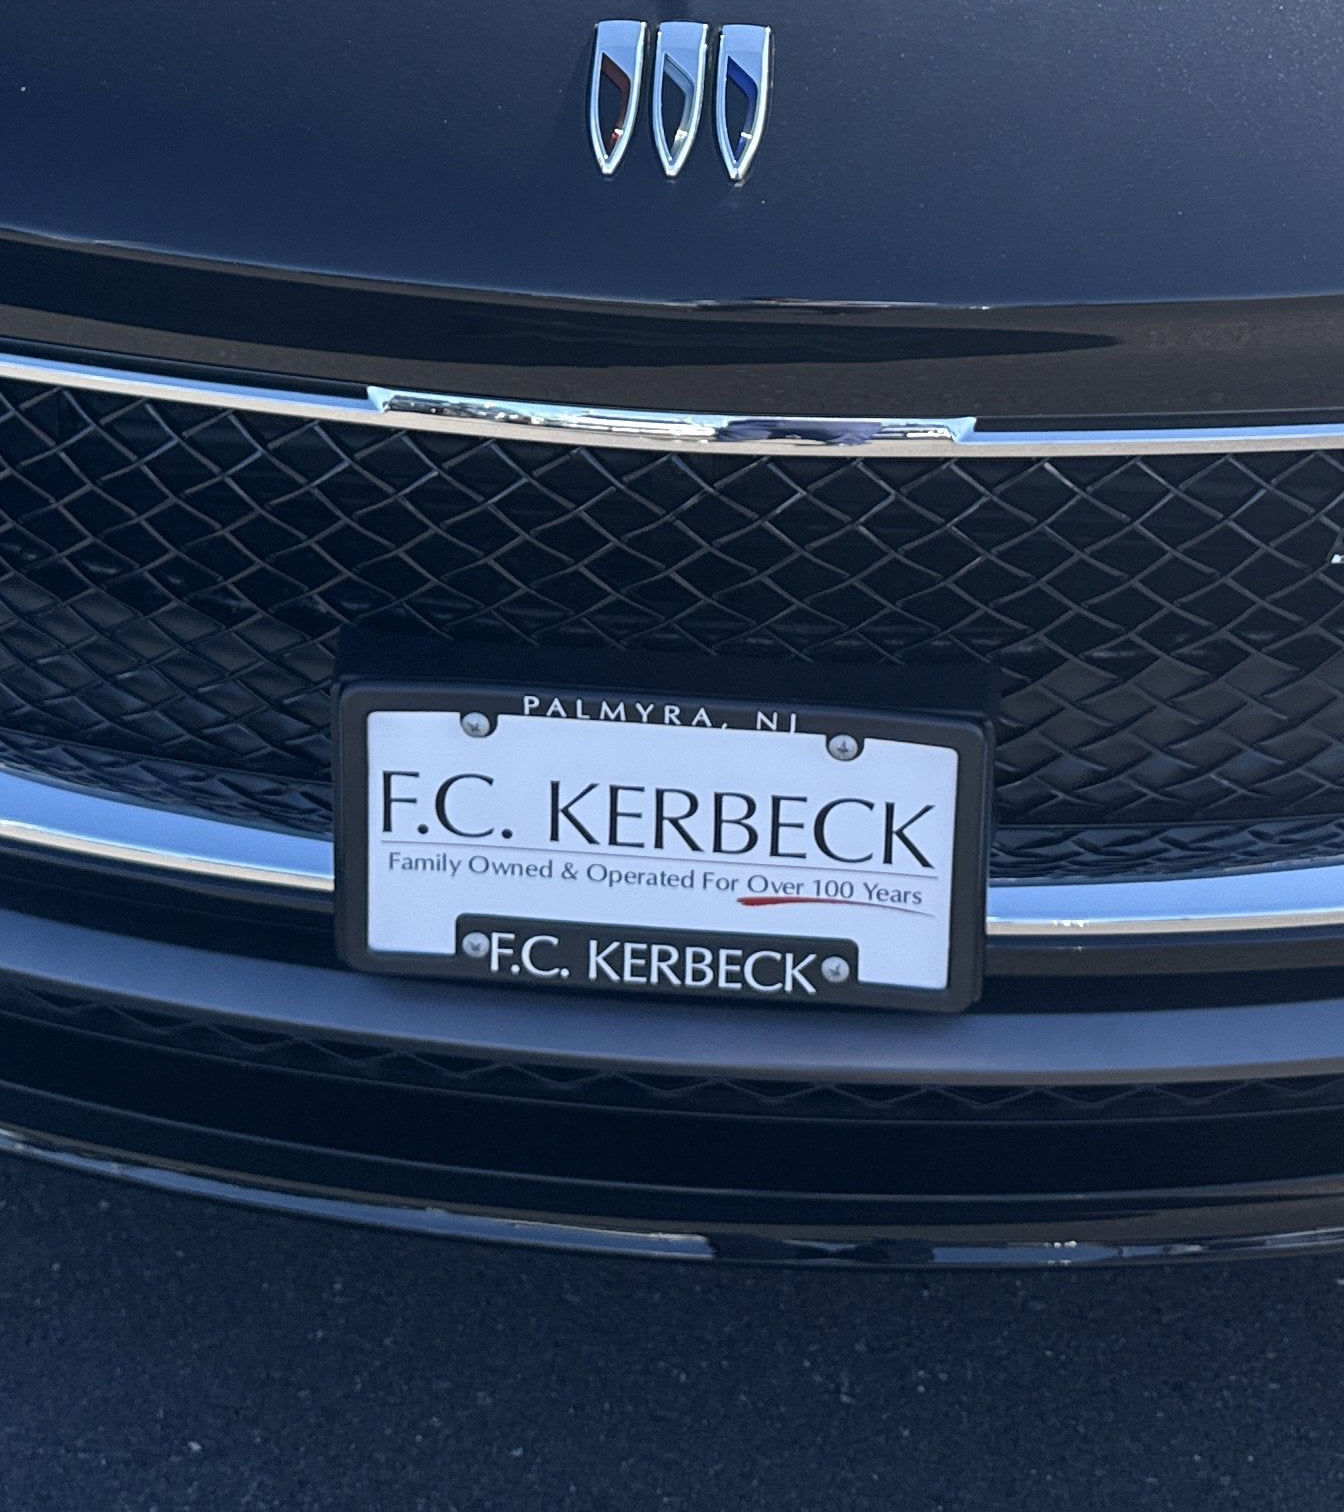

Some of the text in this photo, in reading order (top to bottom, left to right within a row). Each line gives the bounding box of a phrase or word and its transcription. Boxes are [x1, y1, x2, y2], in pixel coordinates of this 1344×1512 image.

[522, 694, 728, 730] PALMYRA,
[381, 769, 936, 869] F.C. KERBECK
[388, 851, 923, 906] Family Owned & Operated For Over 100 Years
[489, 931, 818, 995] F.C. KERBECK
